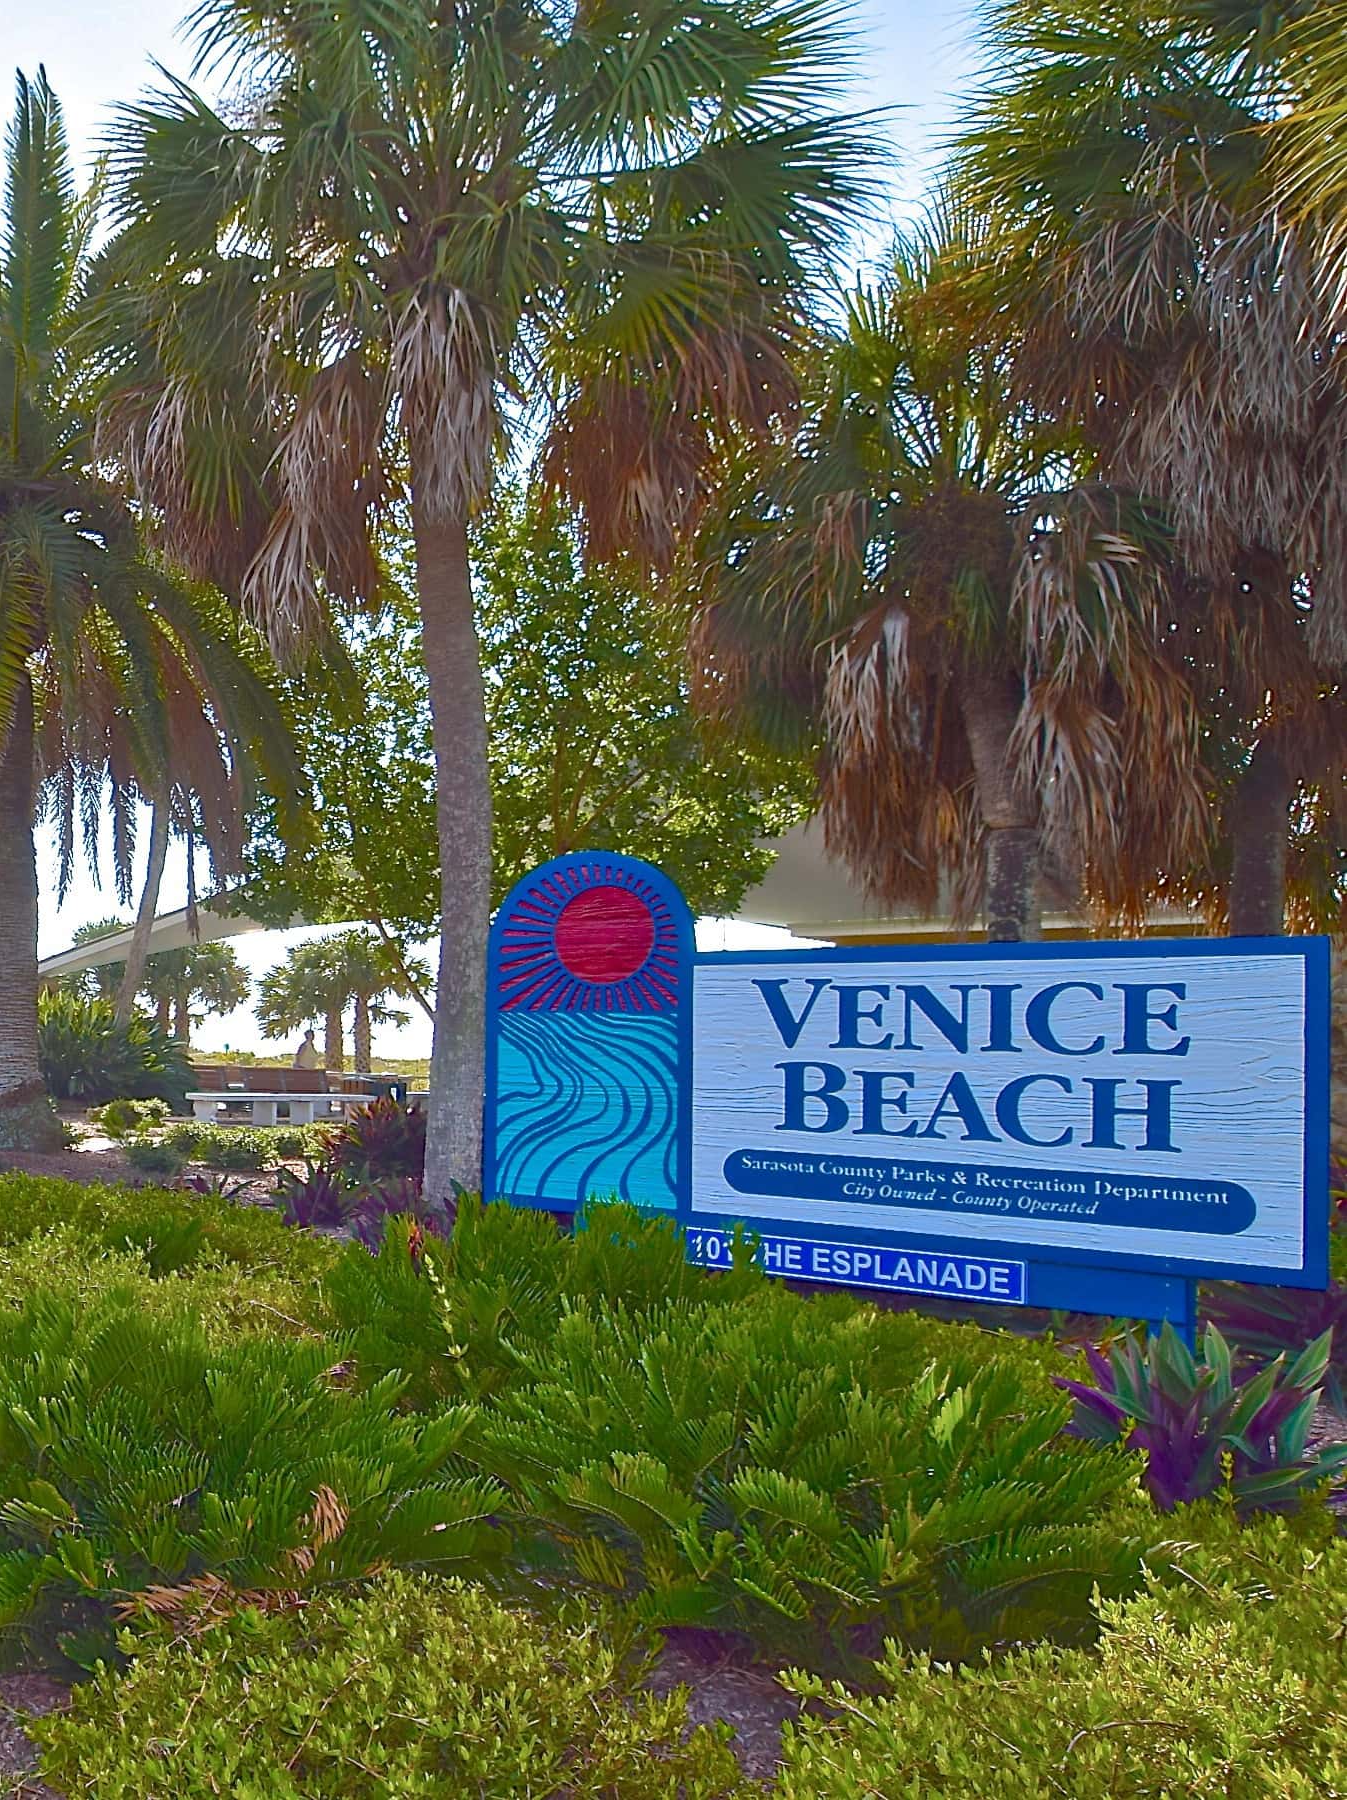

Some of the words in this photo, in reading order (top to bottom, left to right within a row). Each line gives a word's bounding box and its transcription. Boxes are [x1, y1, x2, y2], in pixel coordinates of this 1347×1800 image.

[751, 978, 1192, 1057] VENICE
[773, 1060, 1183, 1154] BEACH
[741, 1155, 814, 1175] Sarasota
[818, 1161, 887, 1182] County
[892, 1166, 946, 1184] Parks
[951, 1170, 967, 1186] &
[975, 1172, 1087, 1195] Recreation
[1094, 1179, 1230, 1205] Department
[842, 1181, 876, 1200] City
[879, 1184, 937, 1202] Owned
[952, 1190, 1012, 1210] County
[1017, 1195, 1100, 1216] Operated
[745, 1240, 803, 1271] HE
[811, 1247, 1011, 1295] ESPLANADE
